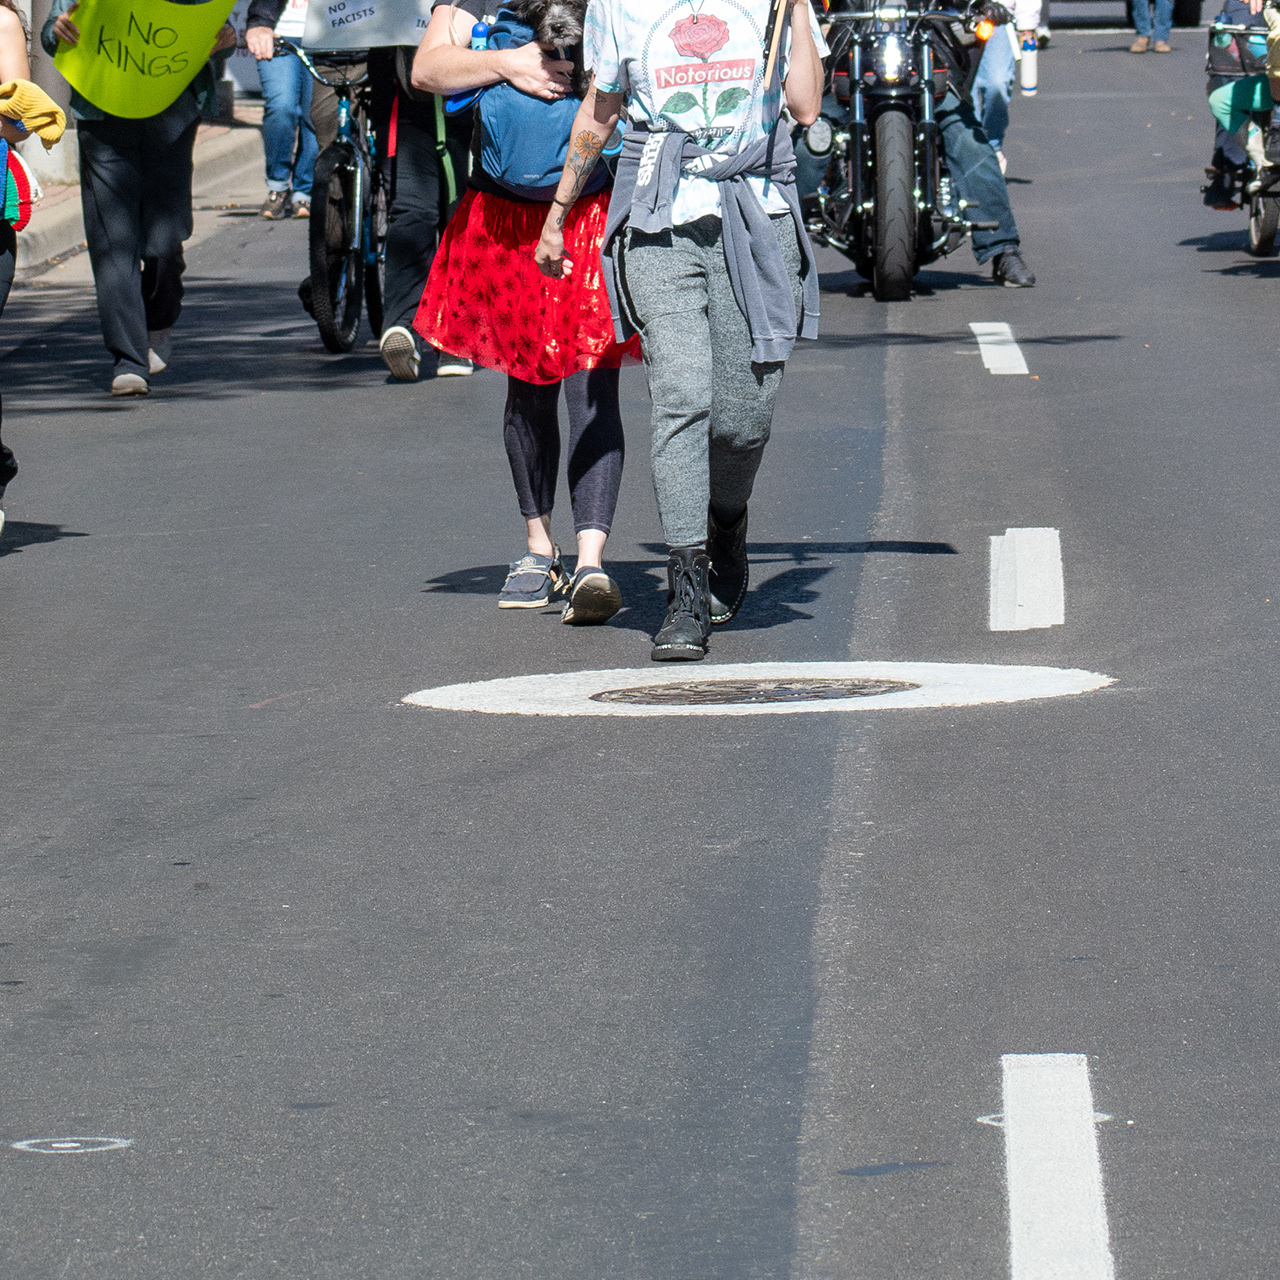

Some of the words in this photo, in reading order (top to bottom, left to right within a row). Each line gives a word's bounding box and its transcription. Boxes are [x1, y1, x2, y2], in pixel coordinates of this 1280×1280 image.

[328, 1, 347, 16] NO
[330, 5, 377, 29] FACISTS
[127, 10, 179, 49] NO
[97, 24, 190, 79] KINGS
[660, 62, 753, 88] Notorious
